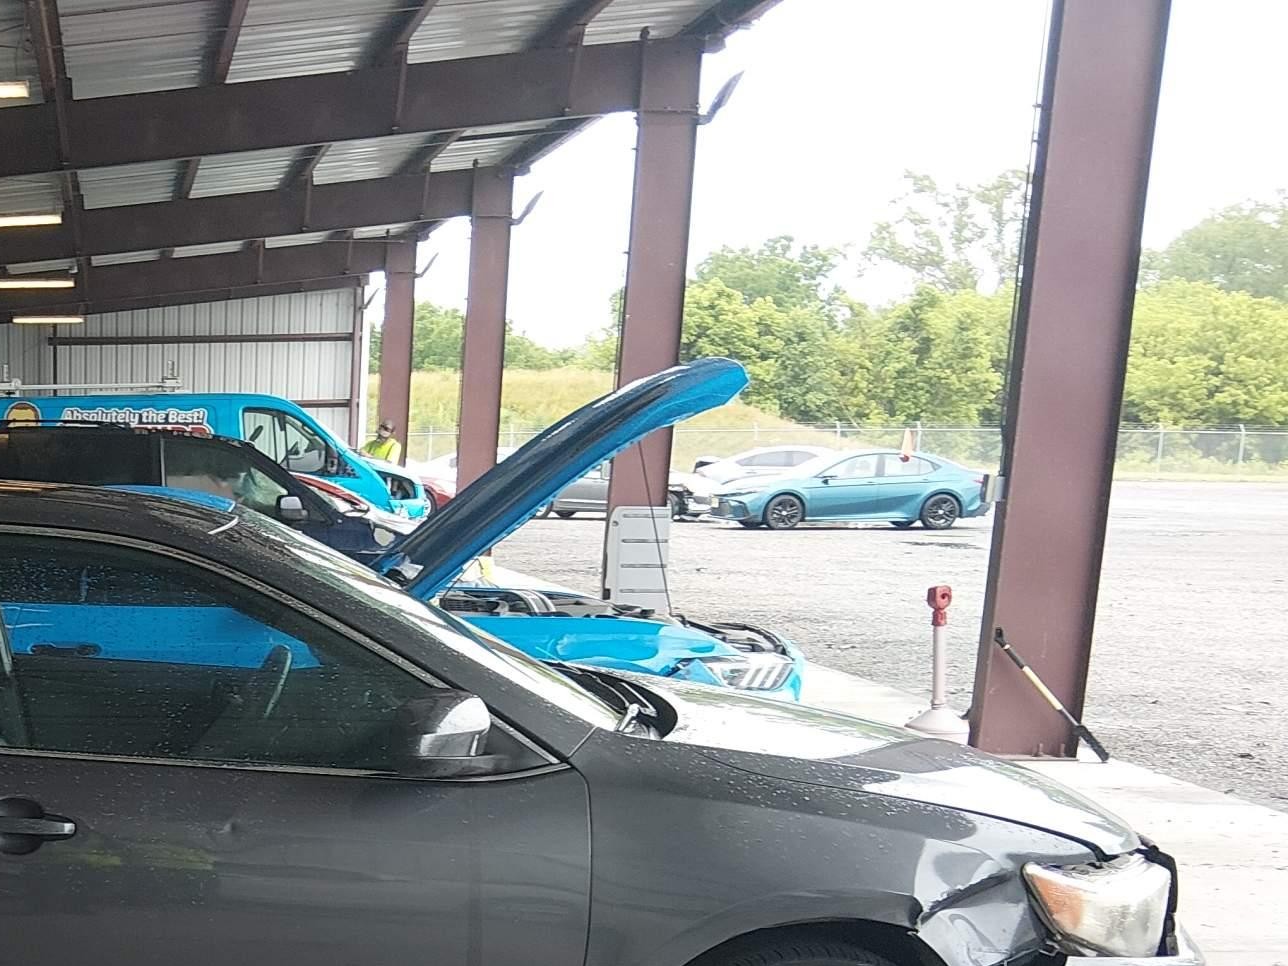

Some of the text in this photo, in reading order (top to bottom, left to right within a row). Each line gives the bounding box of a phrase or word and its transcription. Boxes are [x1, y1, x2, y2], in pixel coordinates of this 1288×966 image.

[63, 409, 204, 424] Absolutely the Best!
